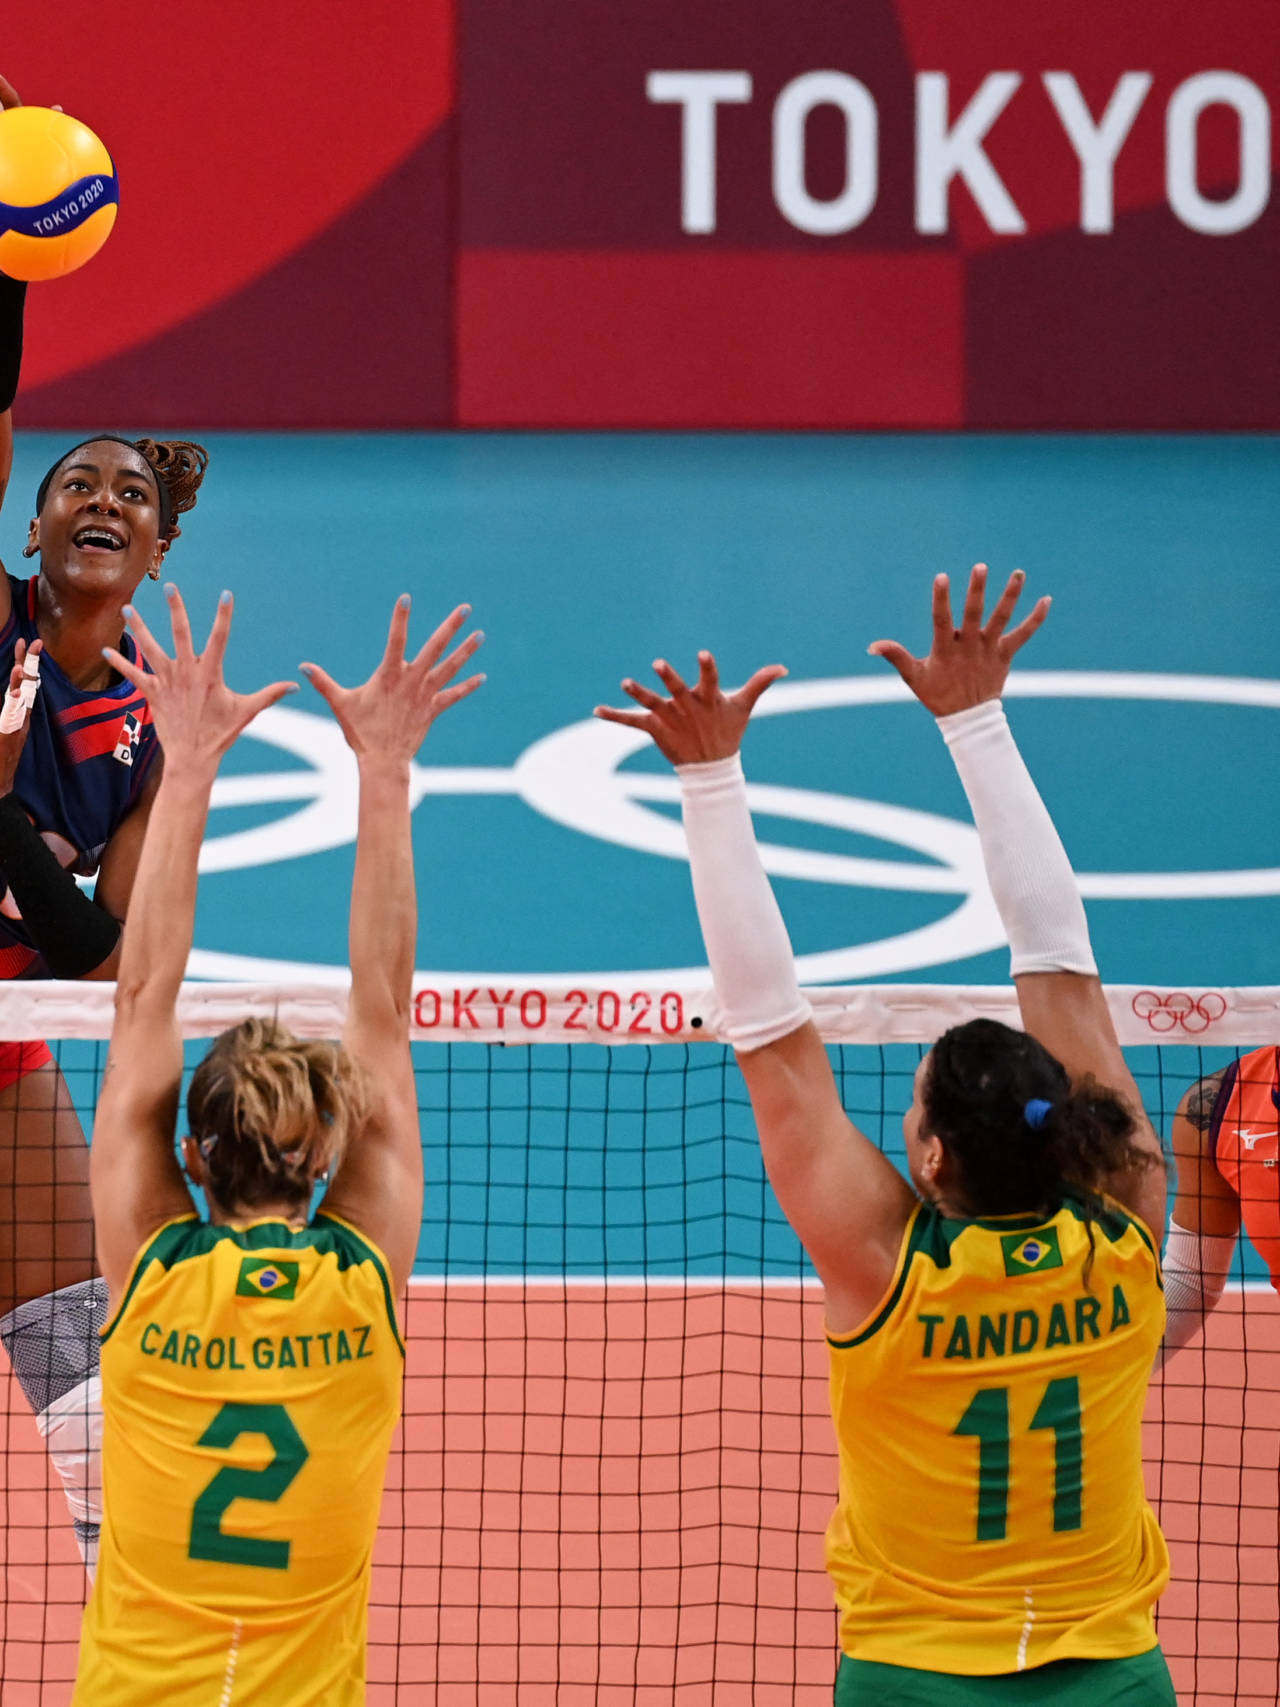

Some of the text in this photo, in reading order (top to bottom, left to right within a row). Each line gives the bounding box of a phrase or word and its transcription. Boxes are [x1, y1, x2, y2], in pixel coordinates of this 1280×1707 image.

[646, 70, 1272, 235] TOKYO
[33, 178, 104, 234] TOKYO 2020
[415, 988, 684, 1034] OKYO 2020
[140, 1322, 374, 1370] CAROL GATTAZ
[917, 1284, 1131, 1359] TANDARA
[188, 1402, 310, 1569] 2
[951, 1375, 1083, 1541] 11
